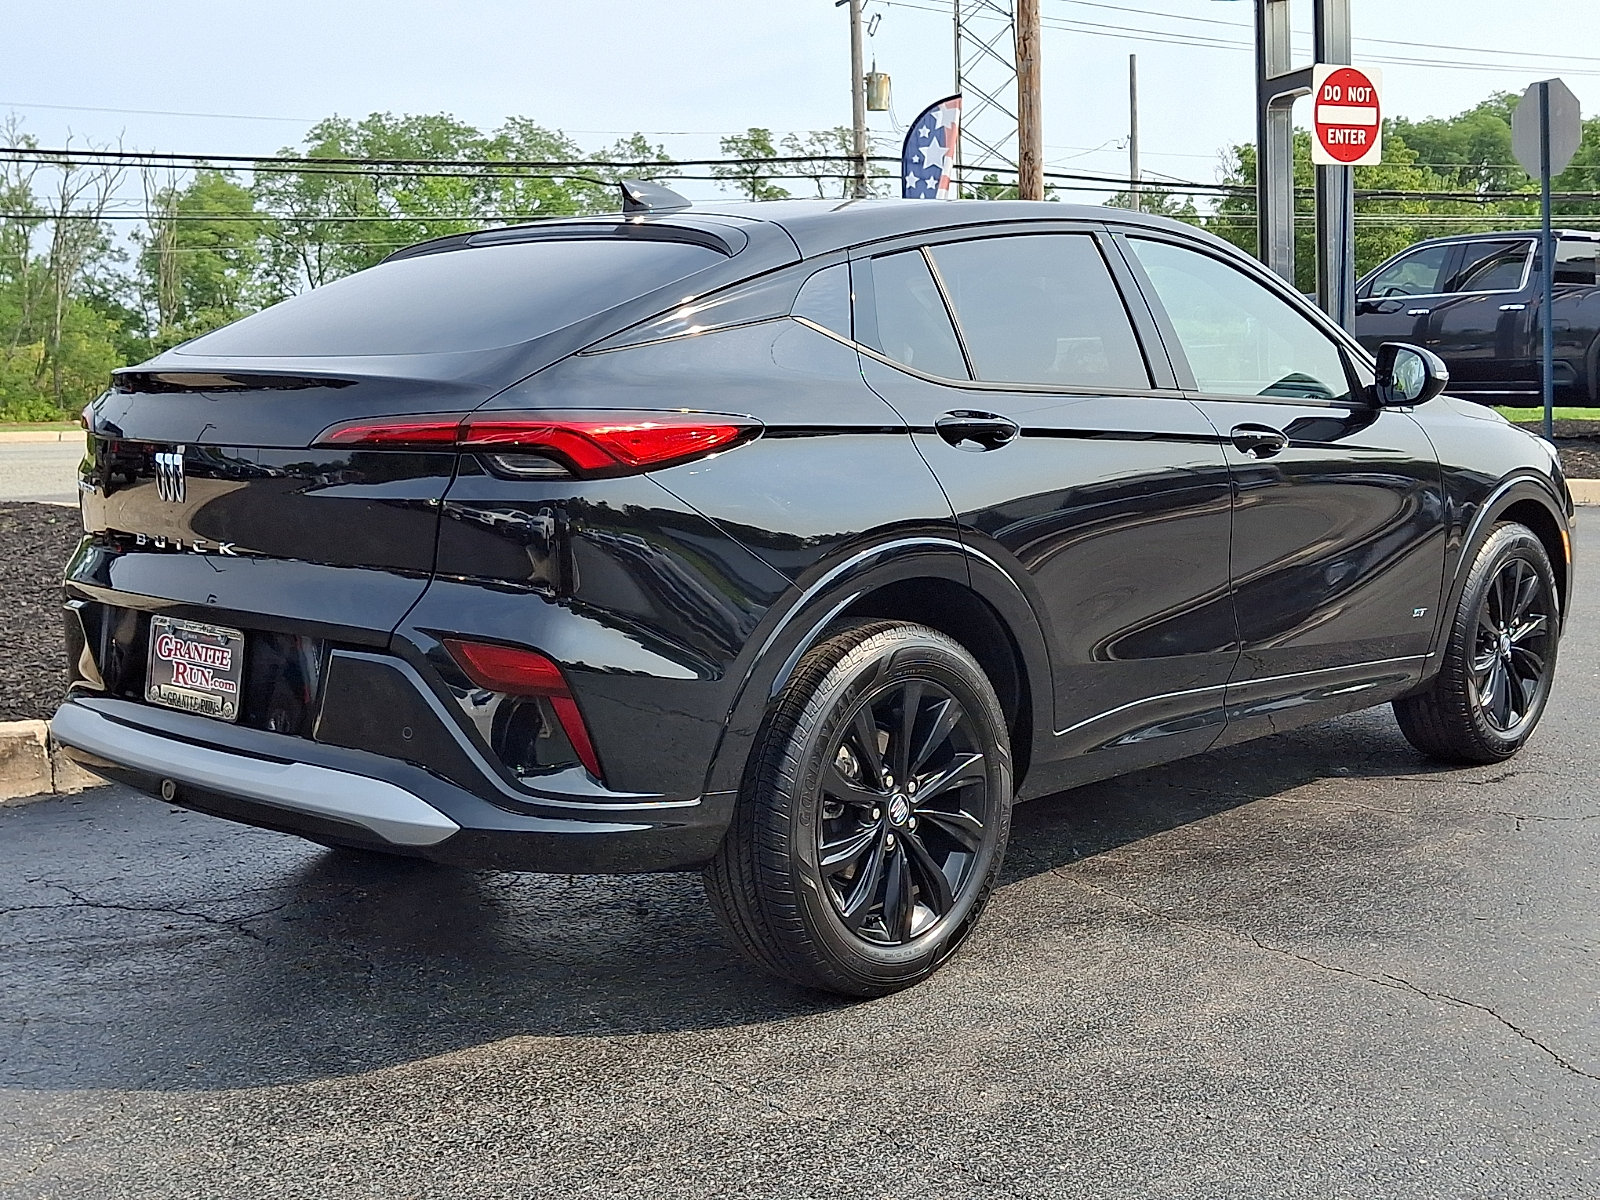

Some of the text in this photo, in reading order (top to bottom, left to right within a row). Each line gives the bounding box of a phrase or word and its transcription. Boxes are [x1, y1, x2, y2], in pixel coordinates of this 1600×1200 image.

[1324, 85, 1372, 103] DO NOT
[1327, 128, 1366, 145] ENTER
[136, 533, 238, 556] BUICK
[157, 634, 231, 669] GRANITE
[167, 691, 199, 711] GRANITE
